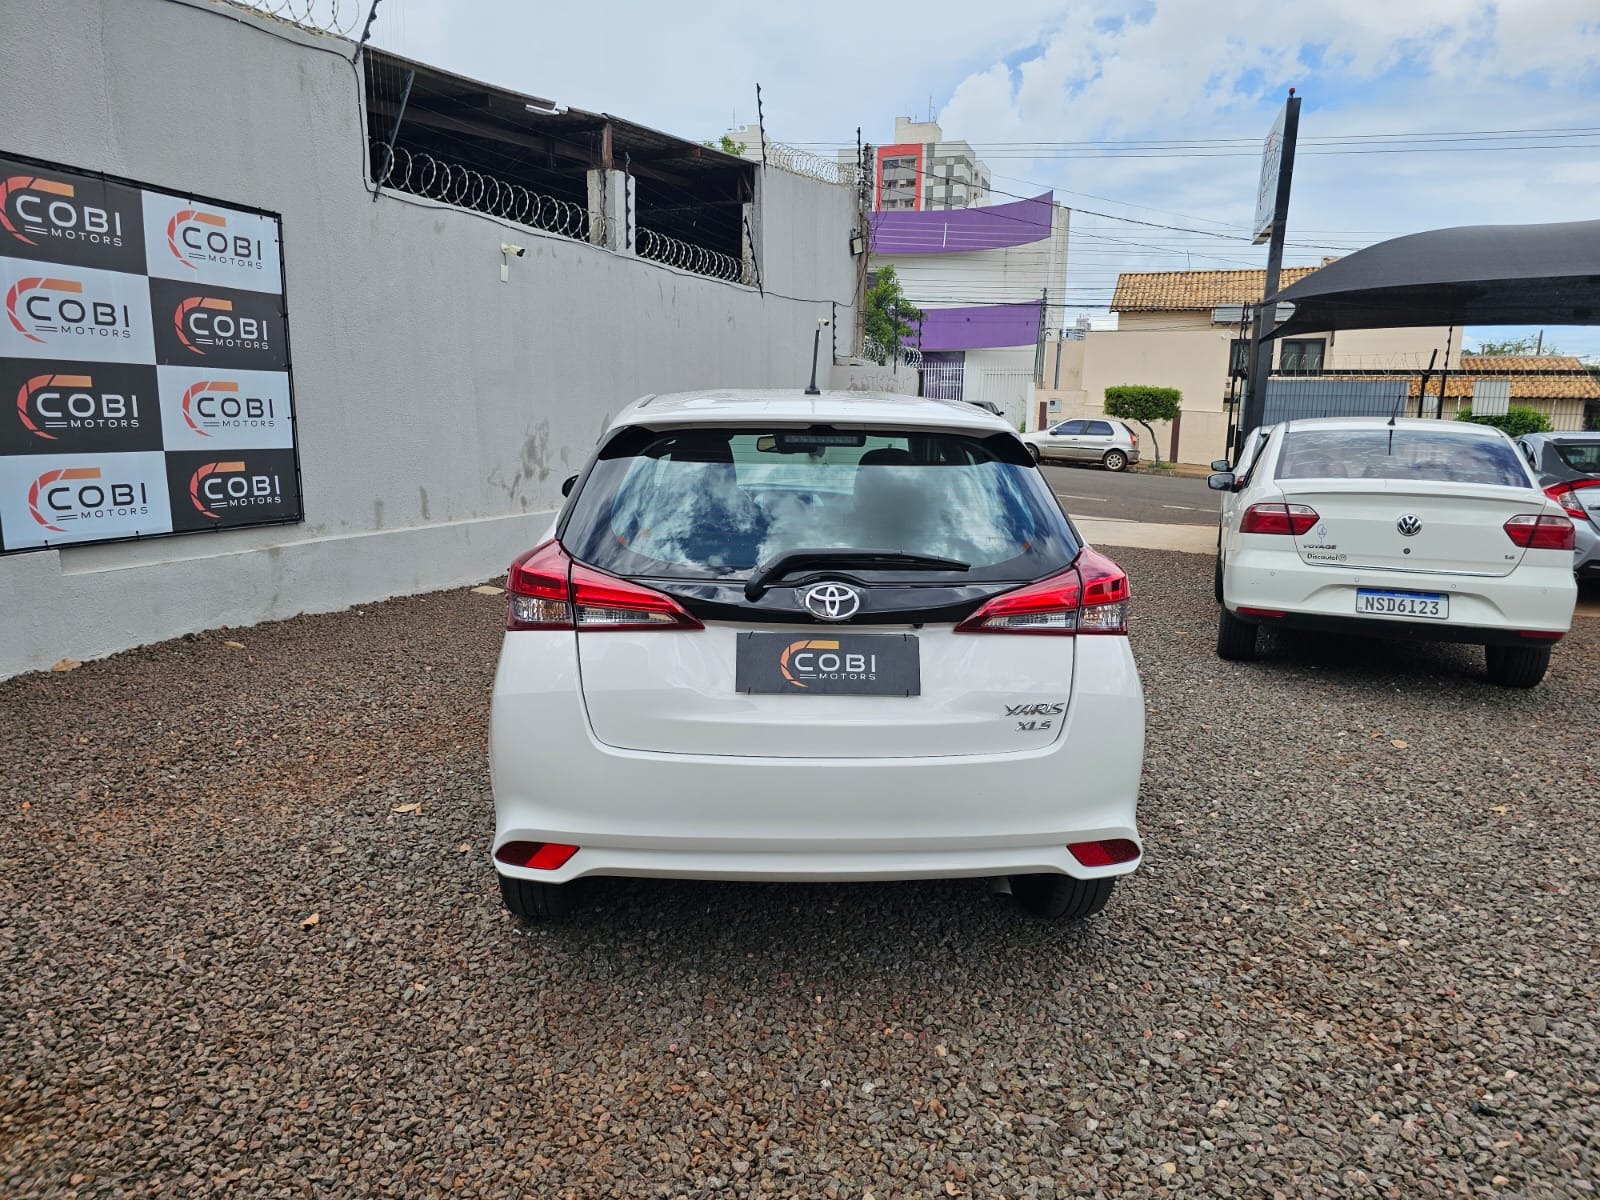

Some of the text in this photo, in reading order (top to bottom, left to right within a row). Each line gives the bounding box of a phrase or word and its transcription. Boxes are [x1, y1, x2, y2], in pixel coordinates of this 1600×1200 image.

[15, 195, 122, 236] COBI
[51, 227, 122, 247] MOTORS
[182, 226, 262, 260] COBI
[208, 254, 263, 270] MOTORS
[26, 296, 130, 328] COBI
[61, 325, 131, 338] MOTORS
[189, 313, 268, 341] COBI
[215, 338, 269, 350] MOTORS
[36, 393, 139, 418] COBI
[197, 397, 275, 419] COBI
[70, 419, 140, 428] MOTORS
[222, 419, 275, 427] MOTORS
[47, 482, 147, 510] COBI
[204, 475, 280, 499] COBI
[229, 496, 281, 507] MOTORS
[81, 506, 149, 519] MOTORS
[1365, 596, 1439, 615] NSD6I23
[794, 653, 876, 672] COBI
[1005, 702, 1065, 716] YARIS
[1015, 719, 1052, 731] XLS
